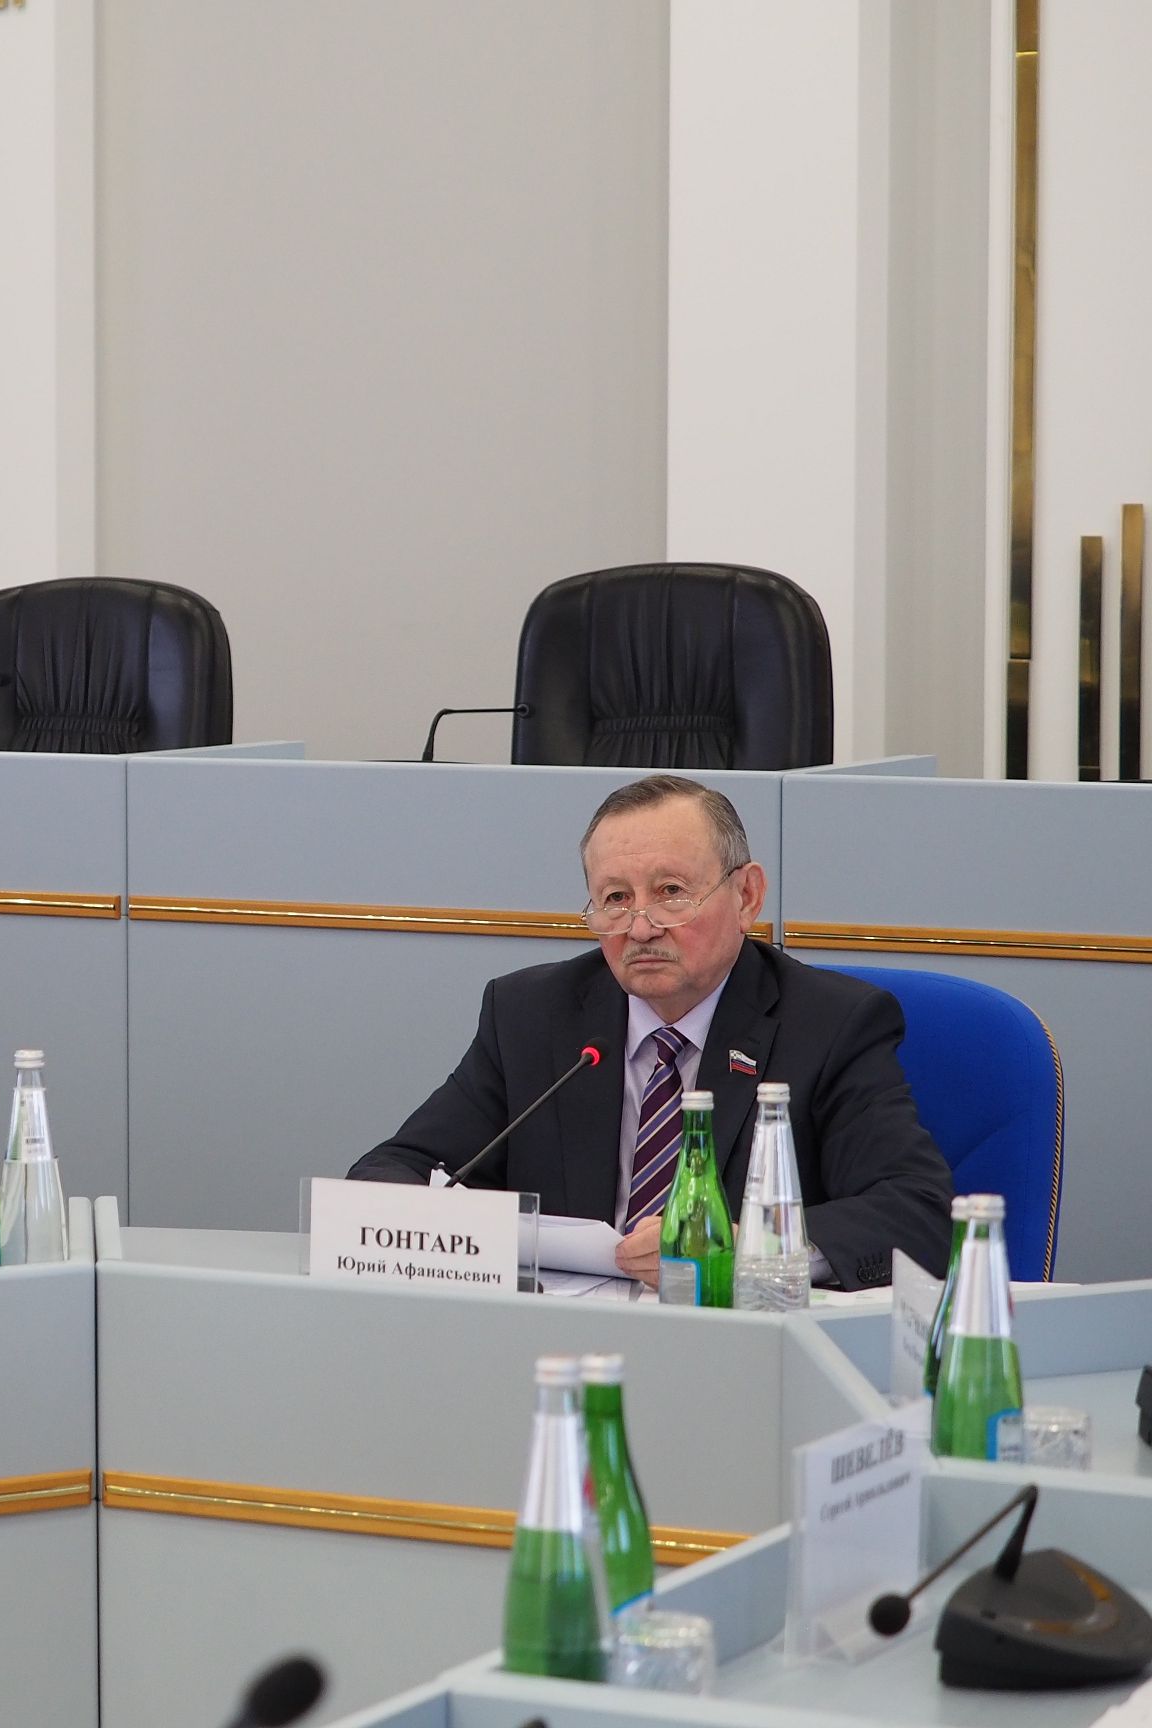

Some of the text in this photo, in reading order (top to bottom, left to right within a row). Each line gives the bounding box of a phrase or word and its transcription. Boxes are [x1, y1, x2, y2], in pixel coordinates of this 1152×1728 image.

[360, 1226, 480, 1256] ГОНТАРЬ
[337, 1255, 501, 1284] Юрий Афанасьевич
